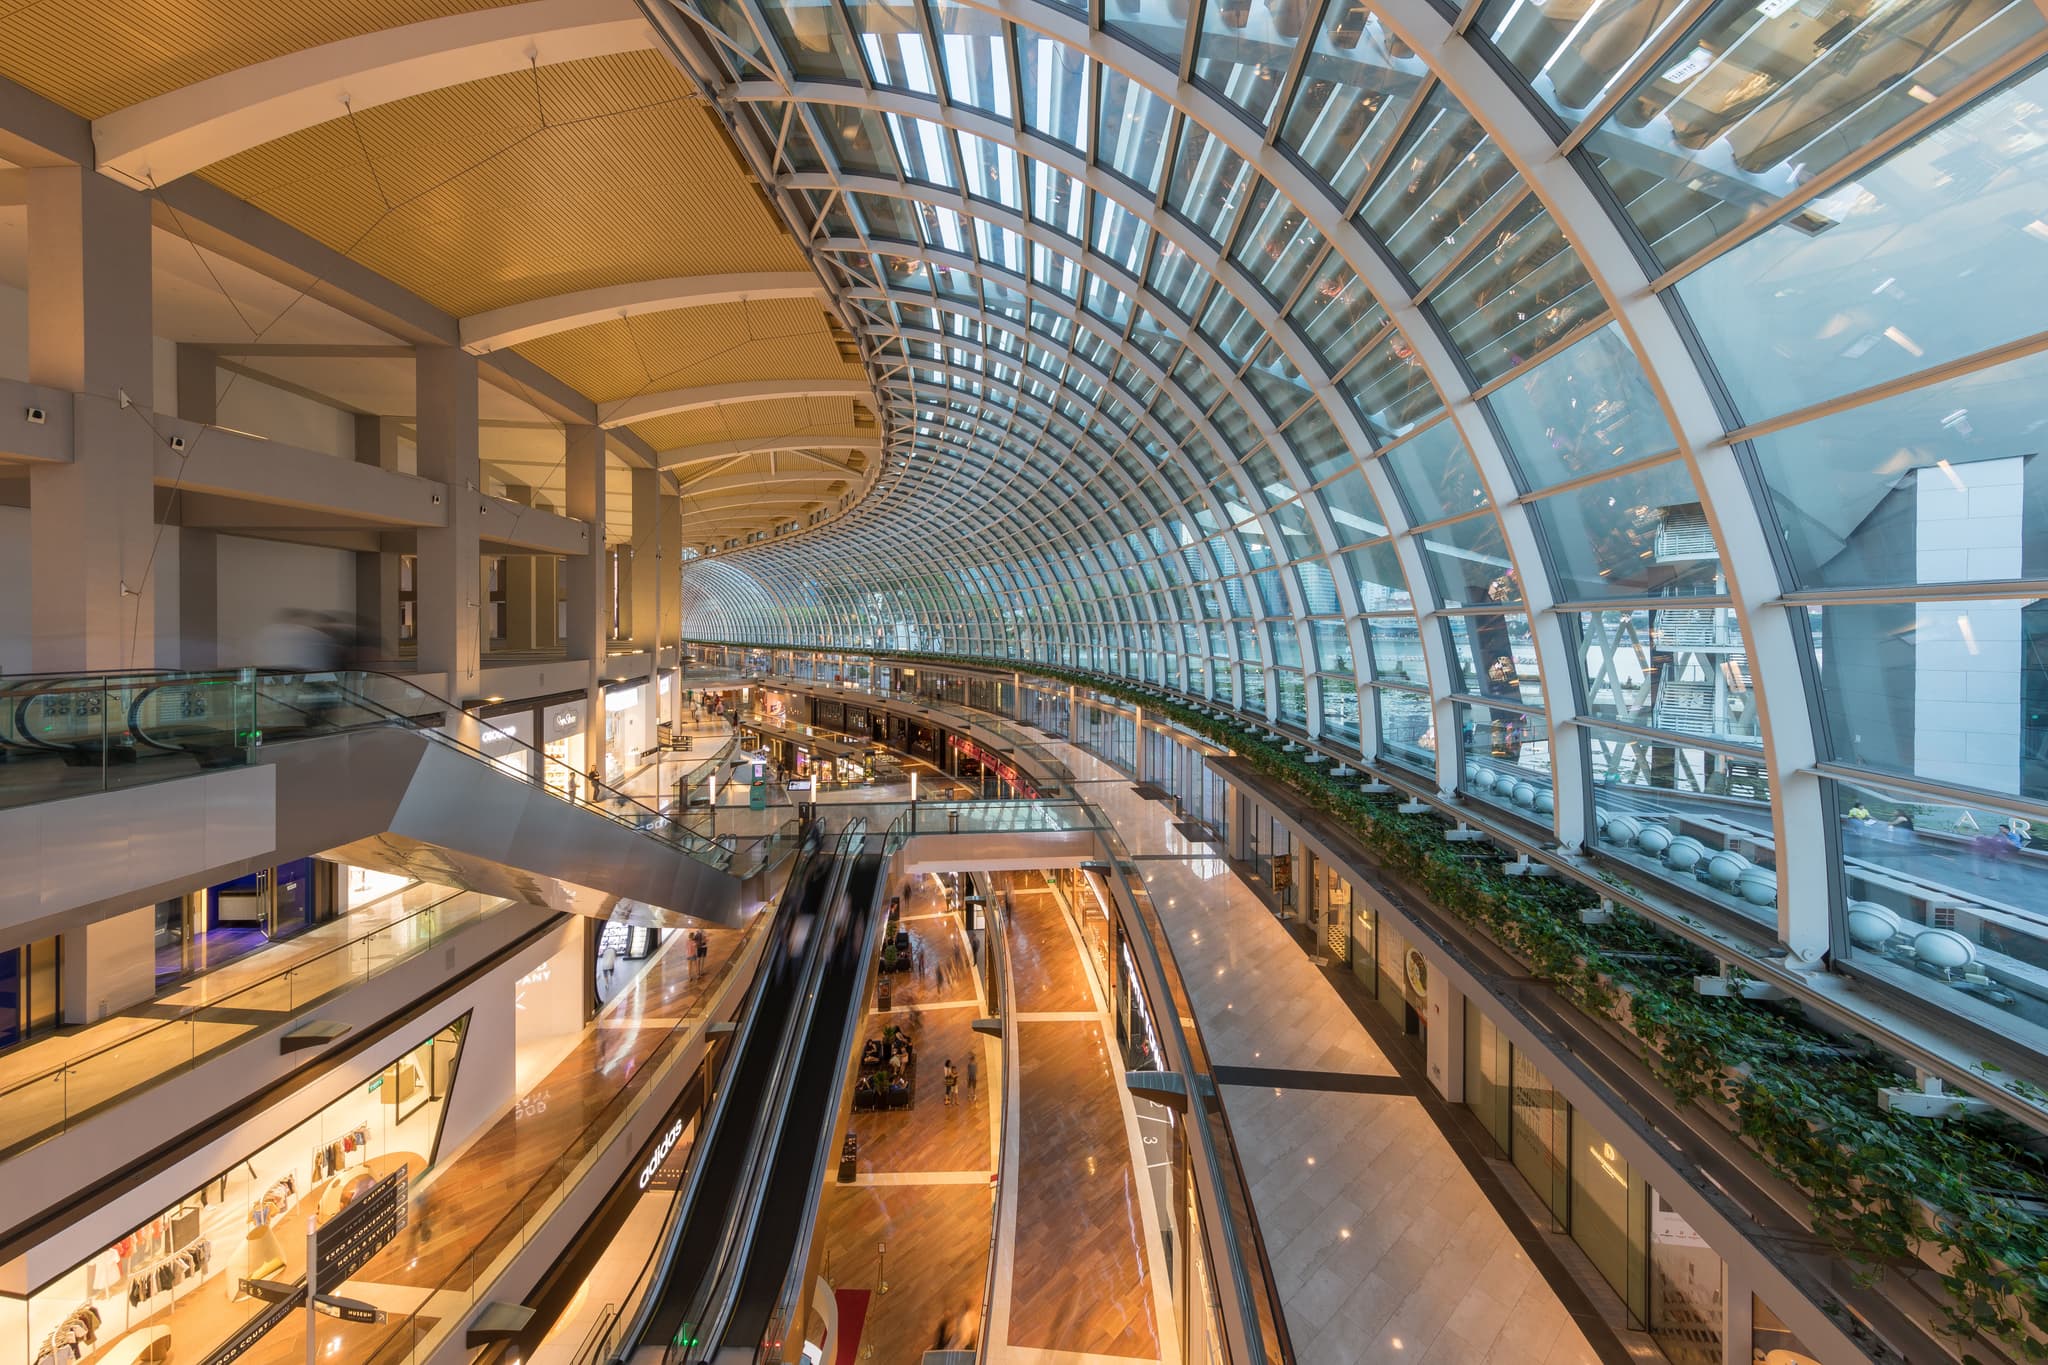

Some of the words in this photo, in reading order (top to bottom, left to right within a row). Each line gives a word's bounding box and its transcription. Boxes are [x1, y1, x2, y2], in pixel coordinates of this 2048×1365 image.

[1143, 1136, 1158, 1145] 3
[639, 1118, 682, 1189] adidas
[362, 1184, 386, 1205] CASINO
[325, 1243, 346, 1262] EXPO
[353, 1203, 395, 1240] CONVENTION
[336, 1246, 361, 1268] HOTEL
[347, 1310, 373, 1318] MUSEUM
[239, 1321, 269, 1349] COURT
